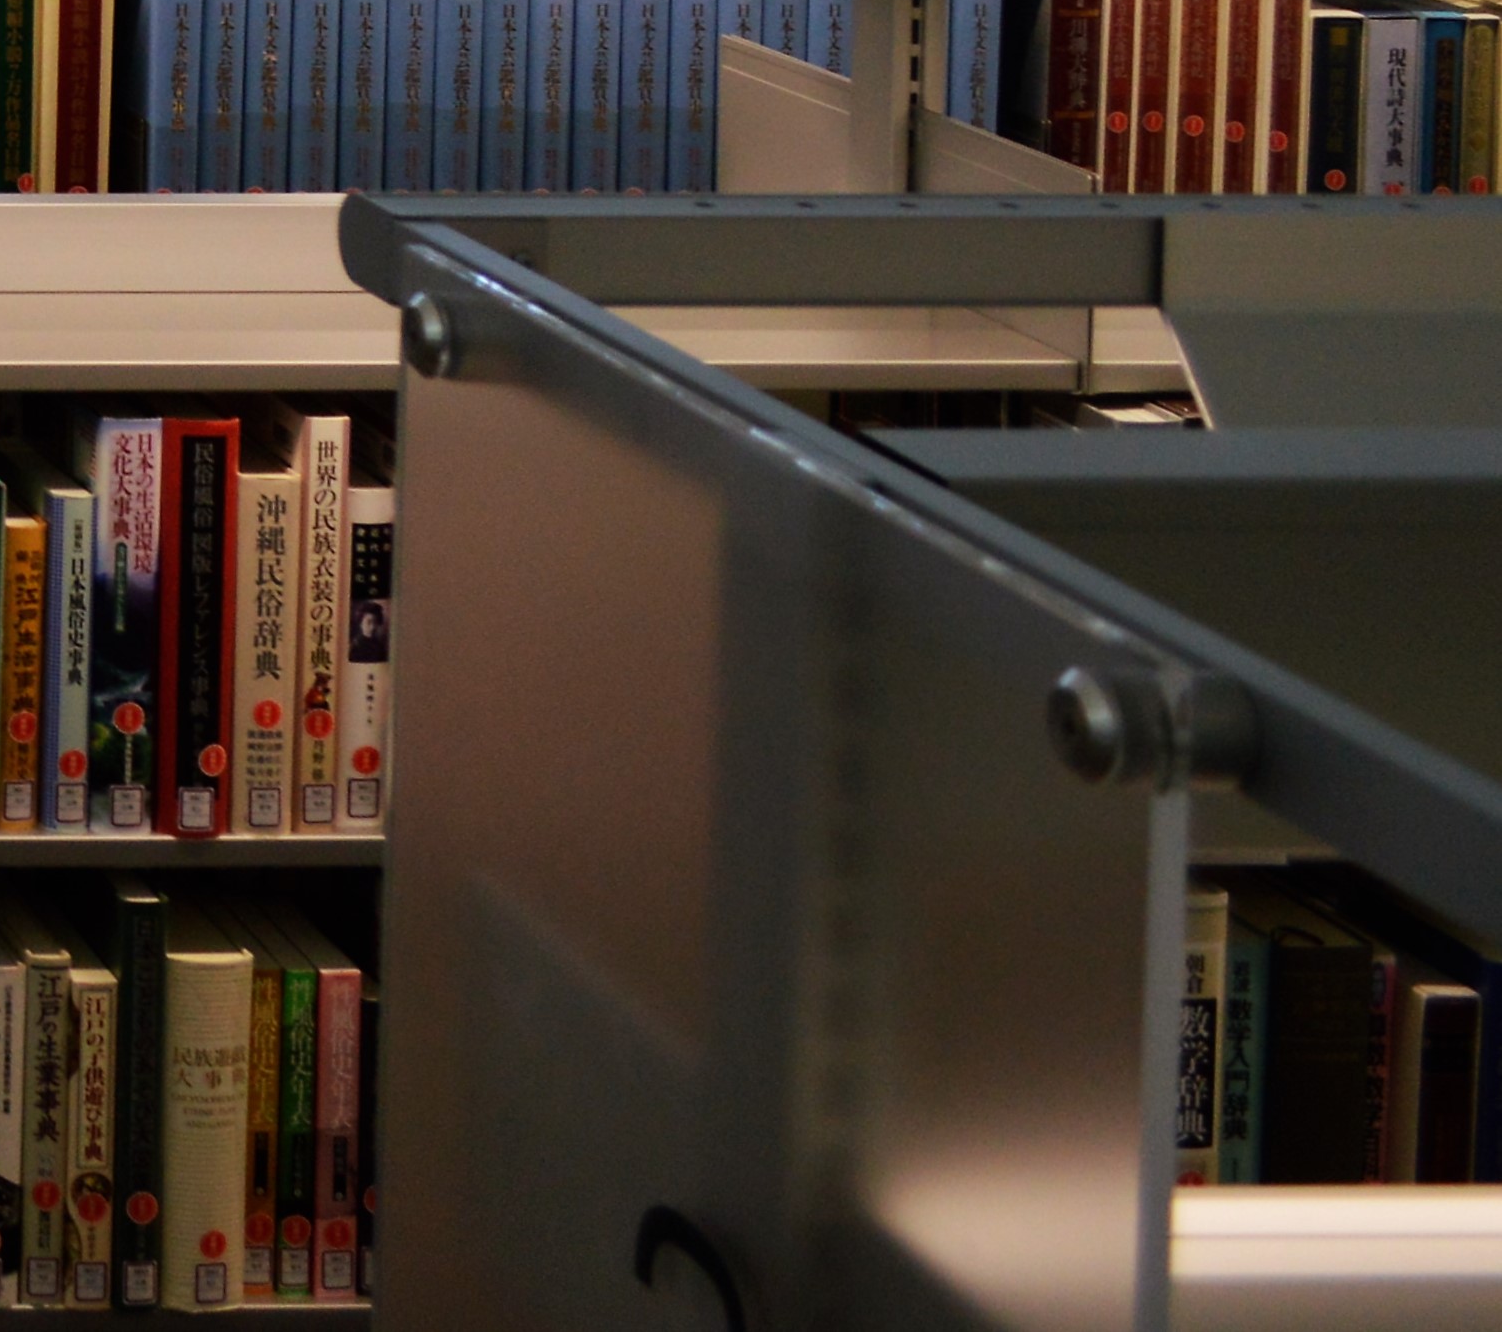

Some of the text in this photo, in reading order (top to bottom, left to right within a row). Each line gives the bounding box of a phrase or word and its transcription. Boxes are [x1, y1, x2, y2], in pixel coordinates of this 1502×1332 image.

[1386, 47, 1407, 168] 現代詩大事典
[112, 433, 133, 541] 文化大事典
[133, 431, 154, 573] 日本の生活環境
[309, 441, 338, 671] 世界の民族衣装の事典
[67, 558, 87, 687] 日本風俗史事典
[35, 974, 62, 1142] 江戸の生業事典
[85, 997, 105, 1161] 江戸の子供遊び事典
[1226, 997, 1253, 1141] 数学入門辞典
